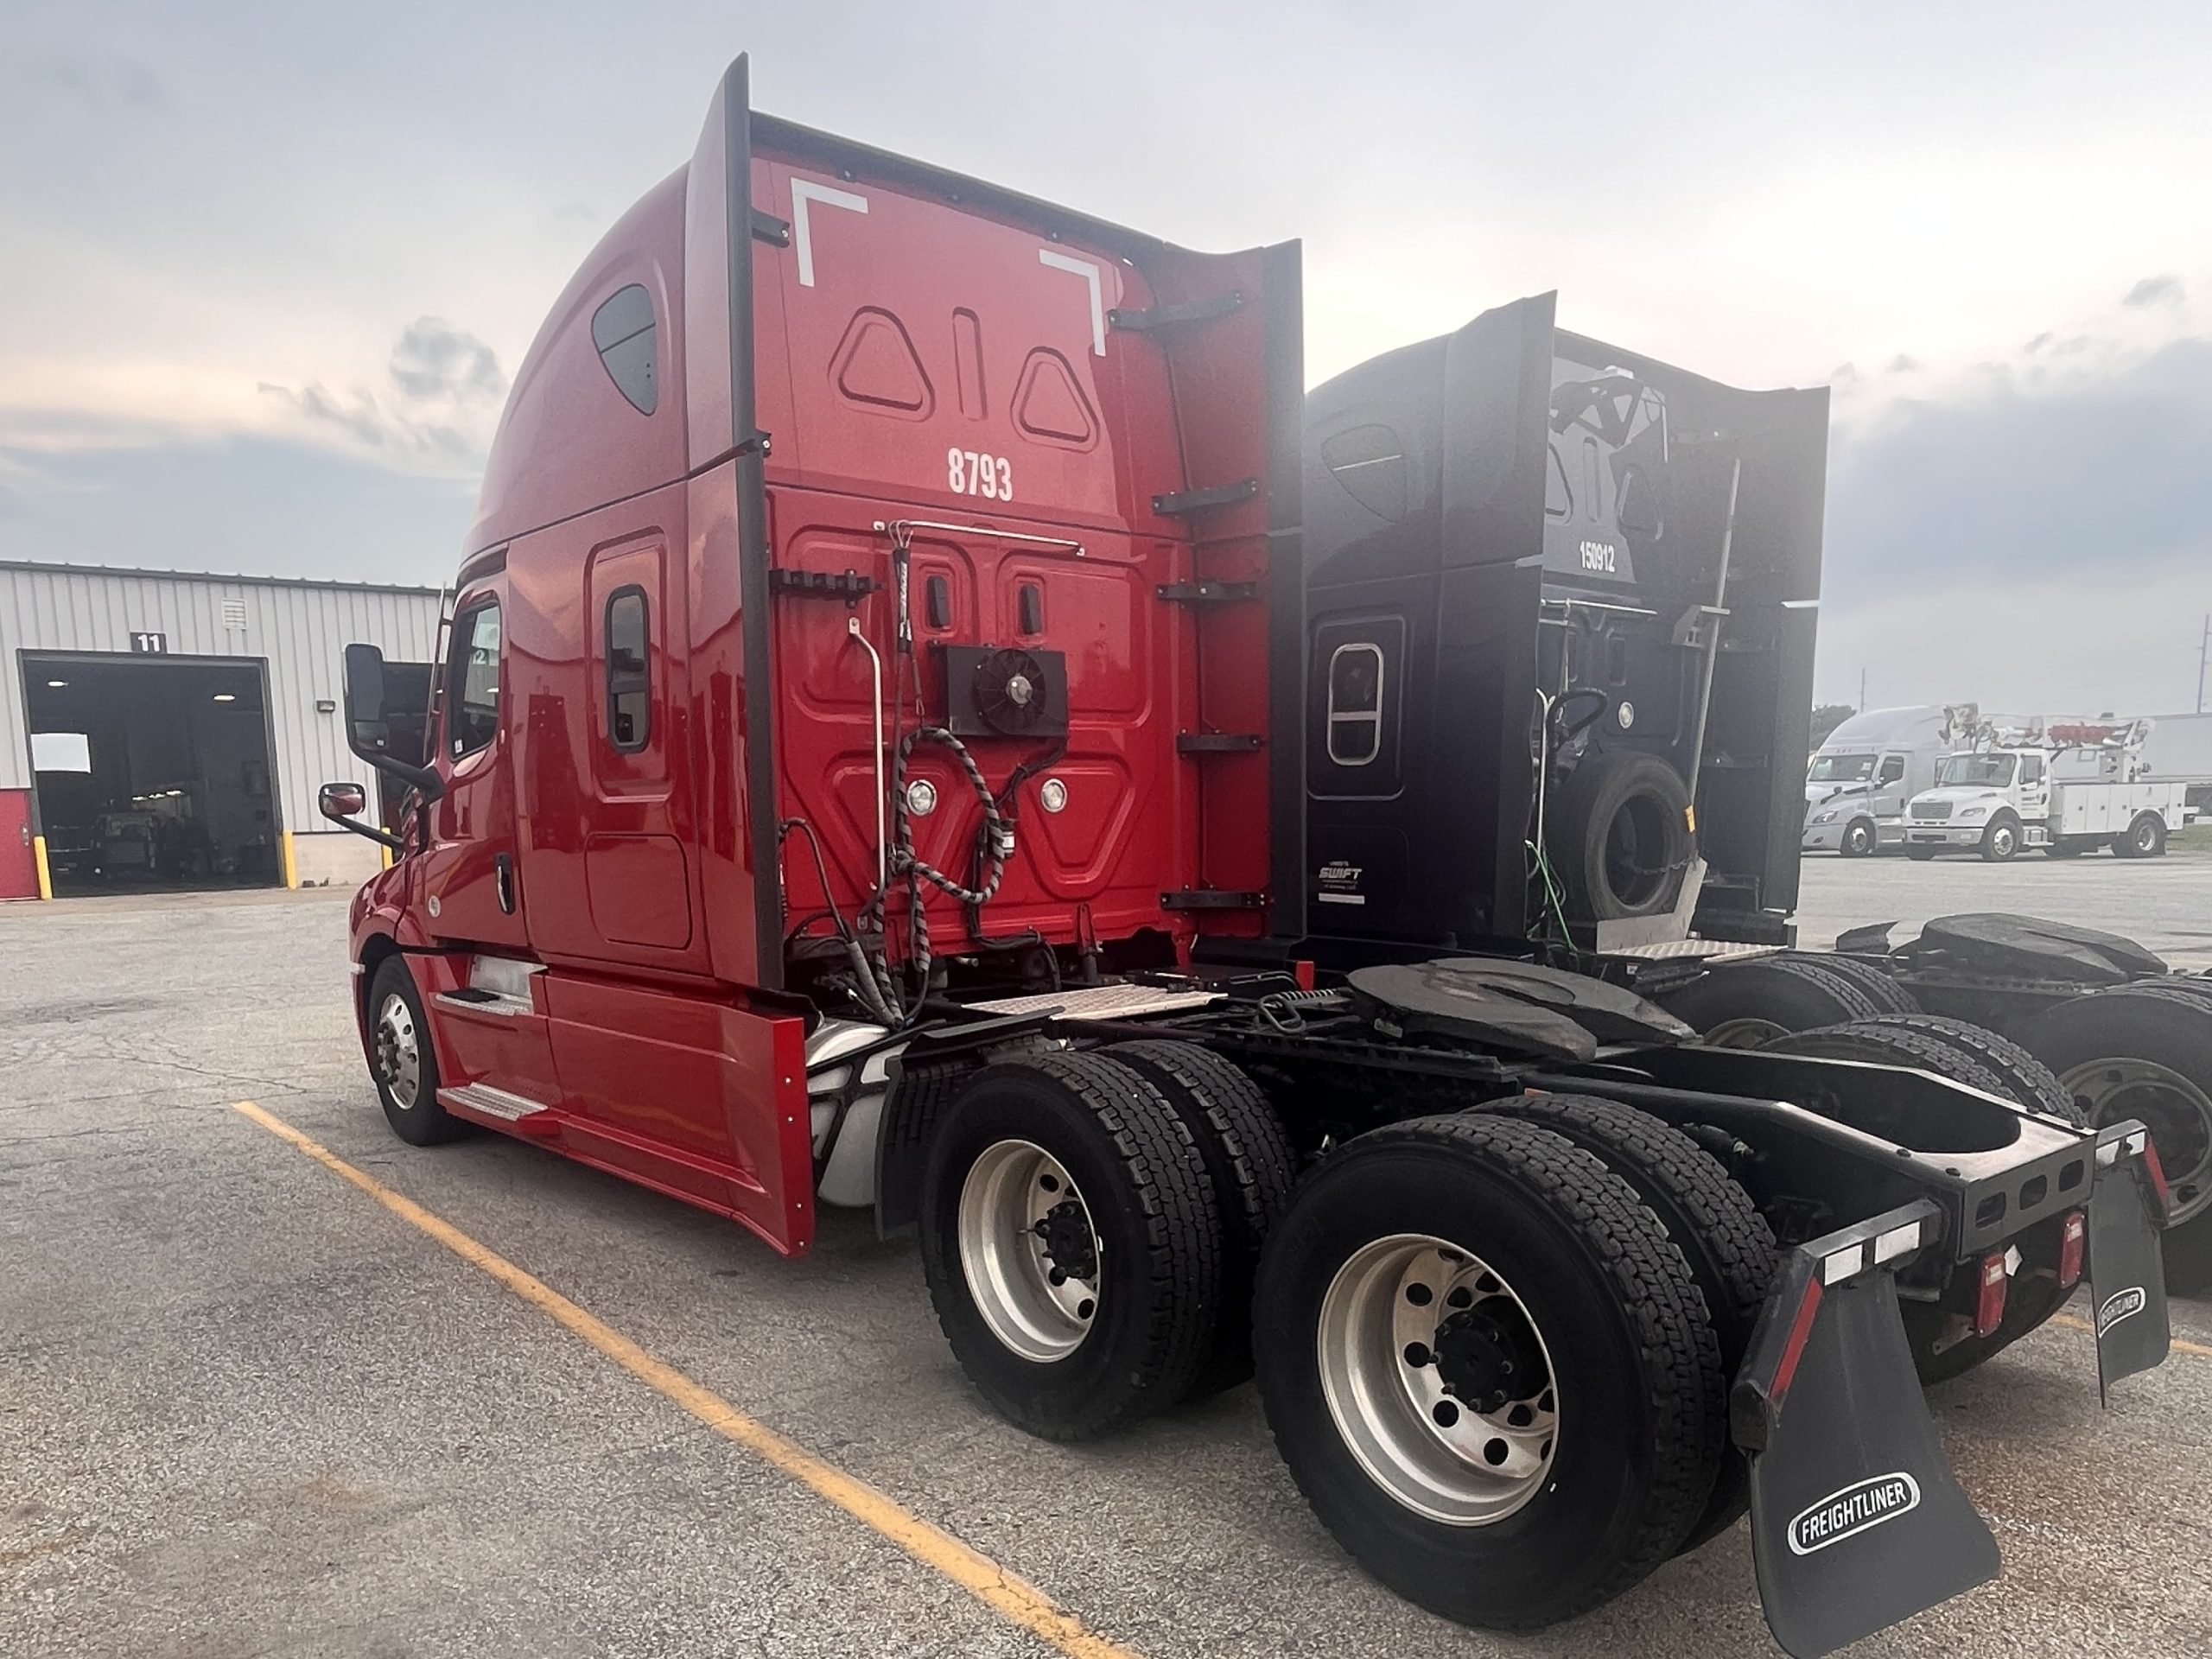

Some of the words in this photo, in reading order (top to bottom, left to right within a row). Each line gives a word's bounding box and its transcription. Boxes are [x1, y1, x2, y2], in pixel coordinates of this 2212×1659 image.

[948, 447, 1013, 501] 8793
[1580, 541, 1615, 572] 150912
[137, 634, 160, 652] 11
[1319, 867, 1363, 880] SWIFT
[1802, 1482, 1907, 1544] FREIGHTLINER
